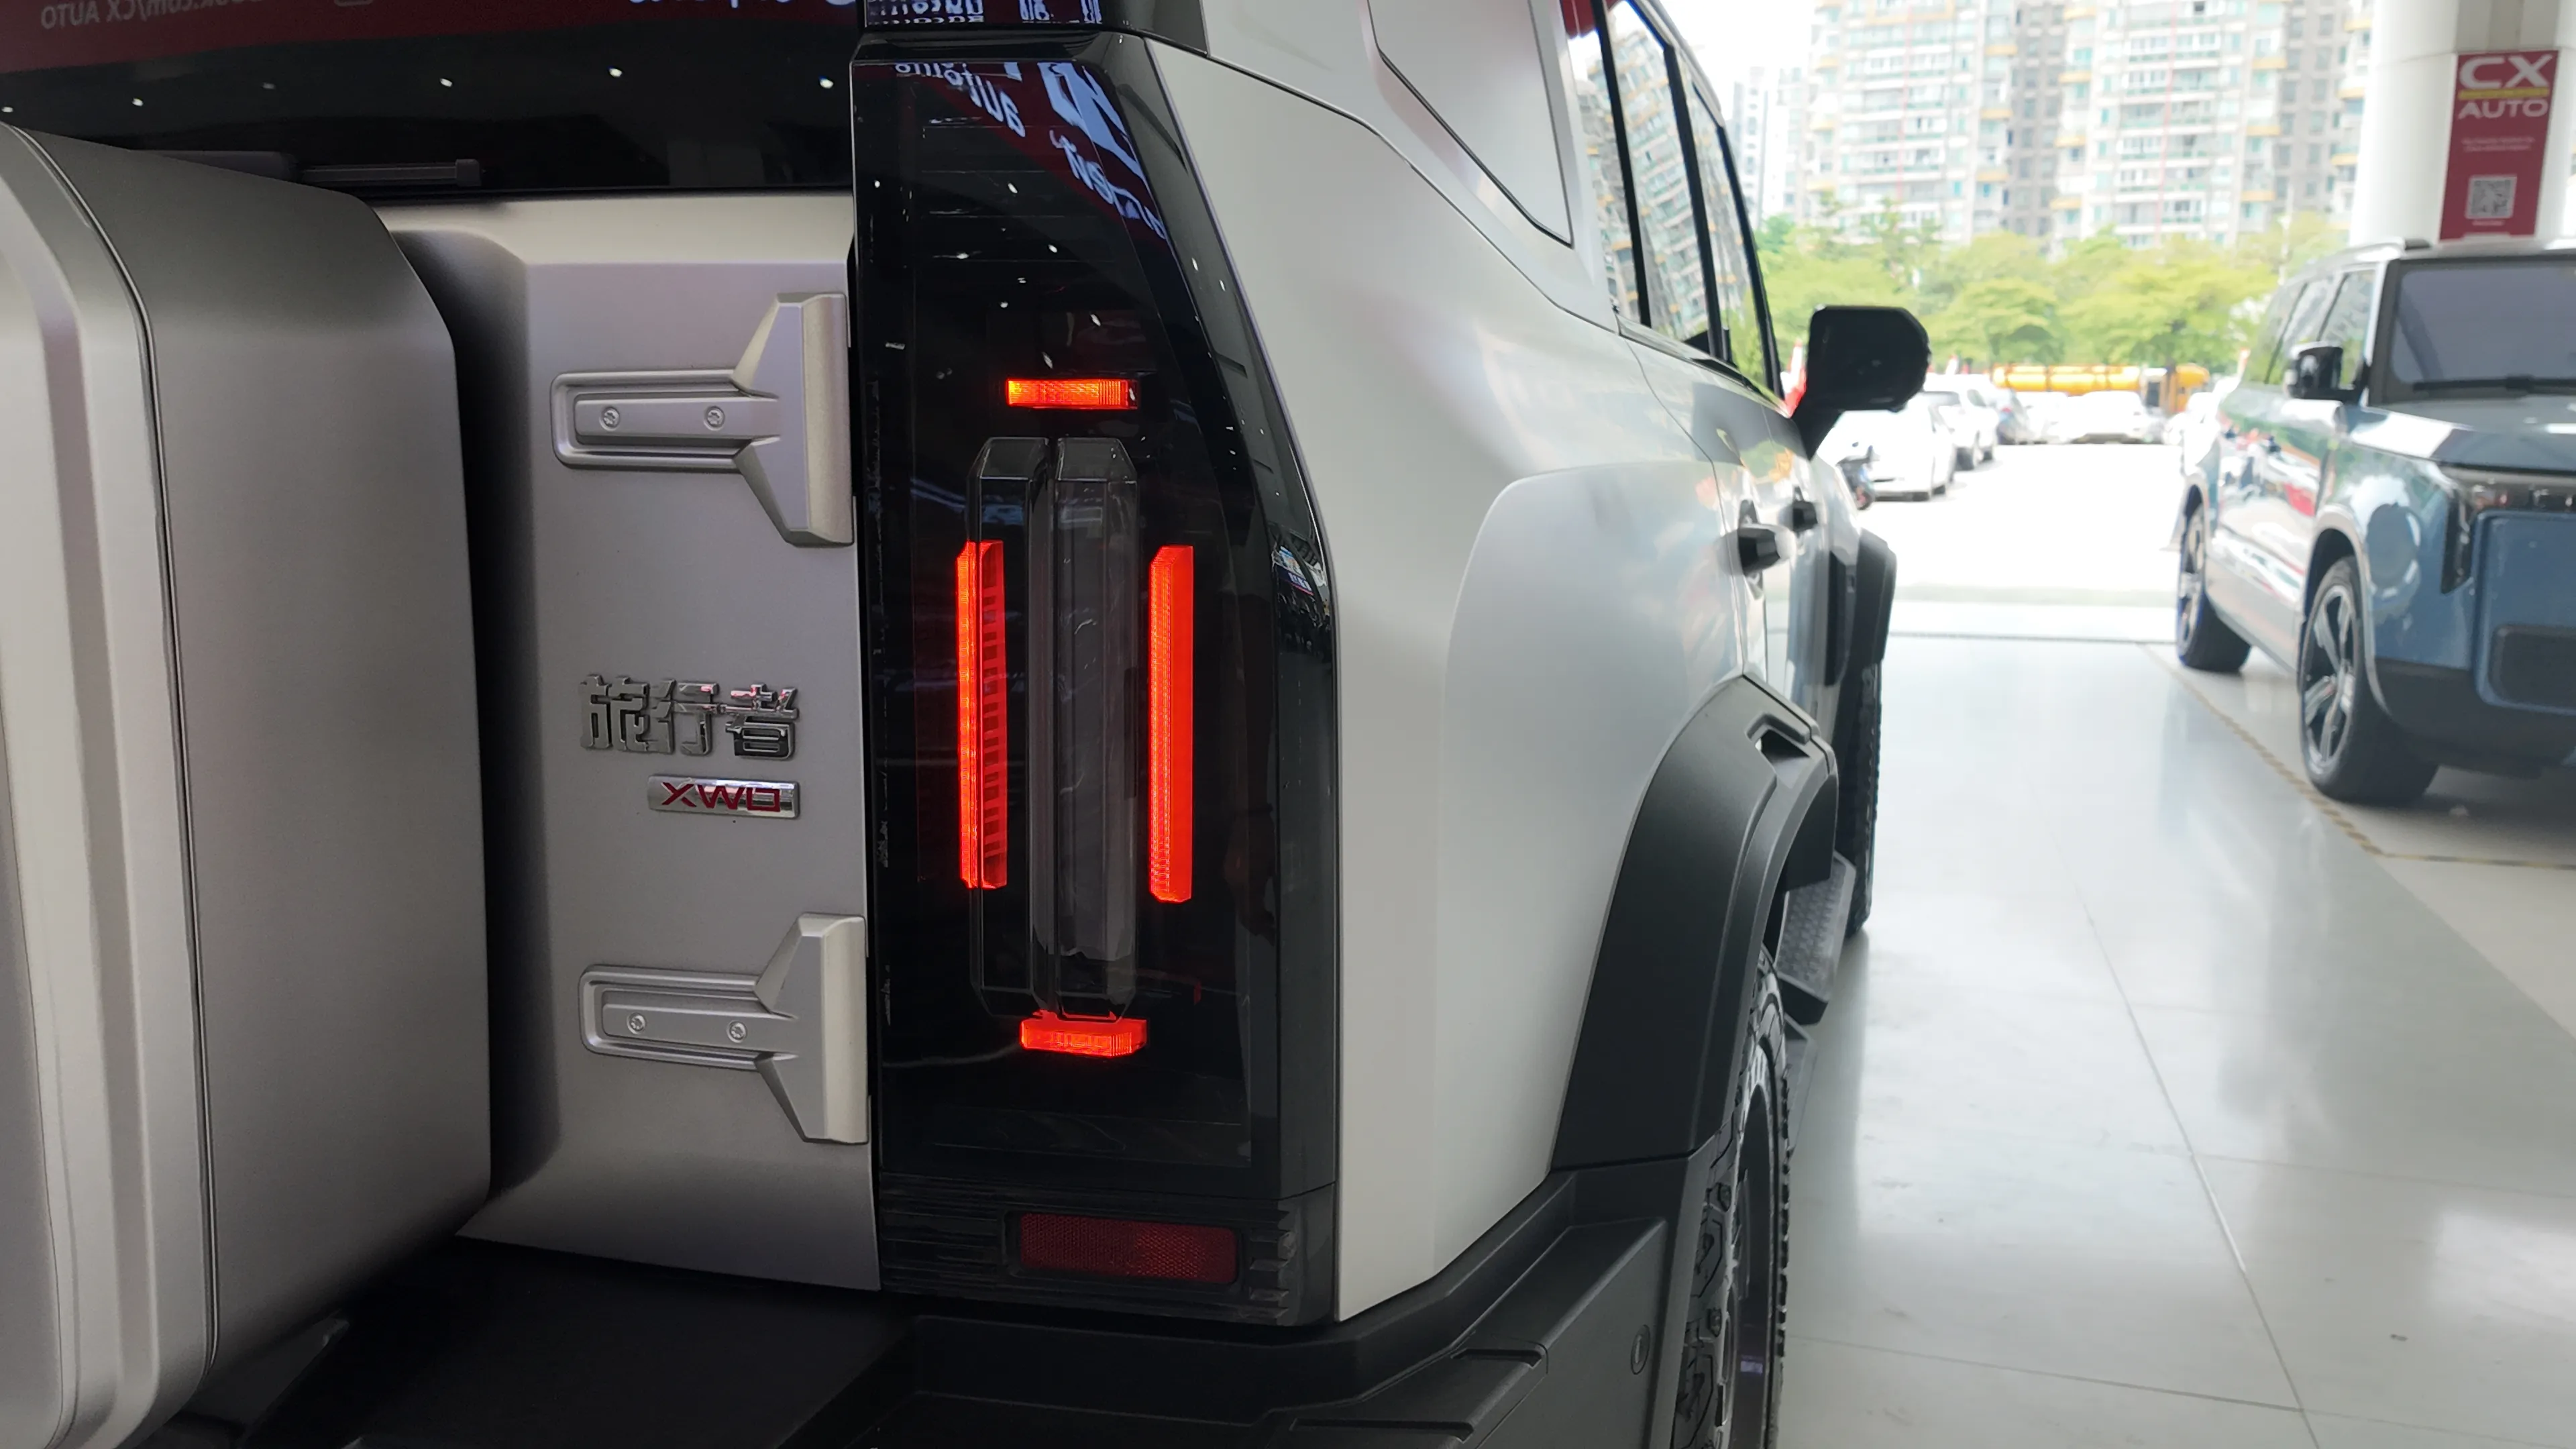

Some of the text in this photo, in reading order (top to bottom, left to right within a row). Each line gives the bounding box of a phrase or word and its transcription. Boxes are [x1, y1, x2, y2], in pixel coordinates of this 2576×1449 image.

[2459, 54, 2553, 90] CX
[2457, 99, 2549, 119] AUTO
[579, 674, 799, 760] 旅行者
[661, 781, 781, 812] XWD
